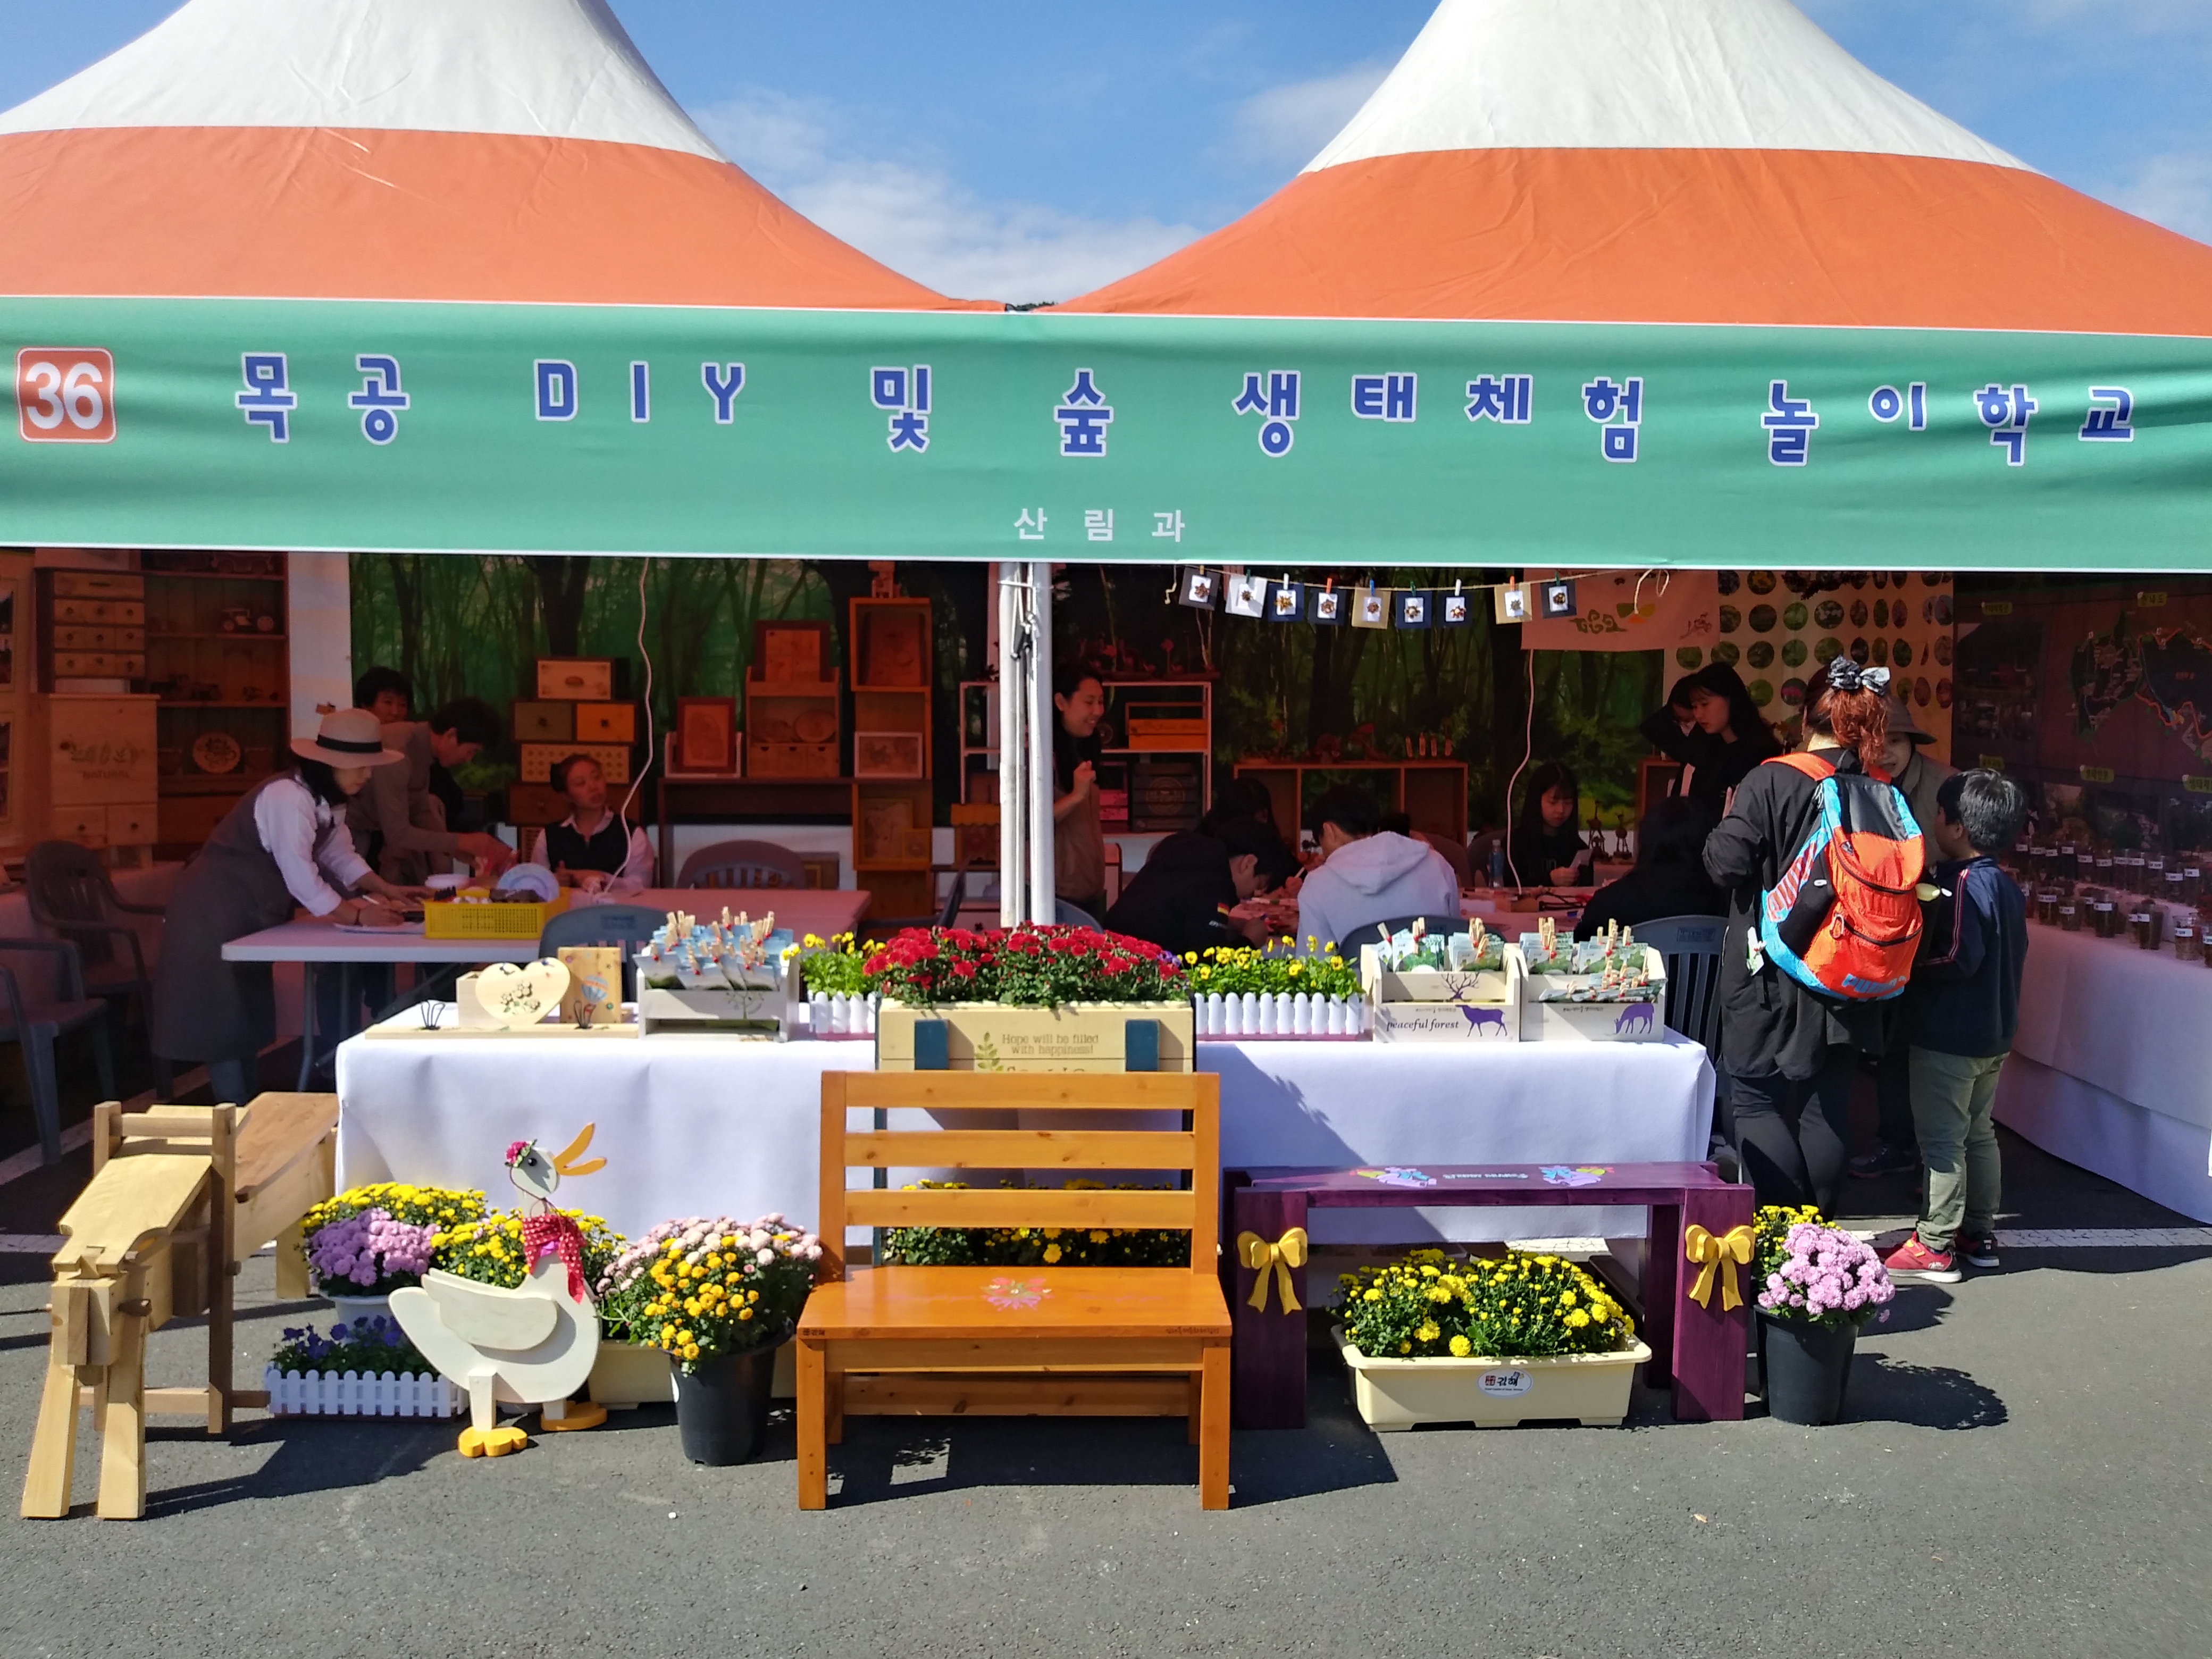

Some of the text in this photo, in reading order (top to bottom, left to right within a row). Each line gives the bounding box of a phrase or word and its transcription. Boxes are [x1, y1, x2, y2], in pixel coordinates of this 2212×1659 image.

[25, 361, 104, 430] 36
[235, 351, 410, 445] 목공
[533, 358, 745, 424] DIY
[870, 364, 932, 454] 및
[1053, 368, 1113, 456] 숲
[1013, 508, 1185, 542] 산림과
[82, 770, 130, 780] NATURAL
[1386, 1018, 1459, 1032] peaceful forest
[1002, 1034, 1099, 1045] Hope will be filled
[1011, 1044, 1093, 1056] with happiness!
